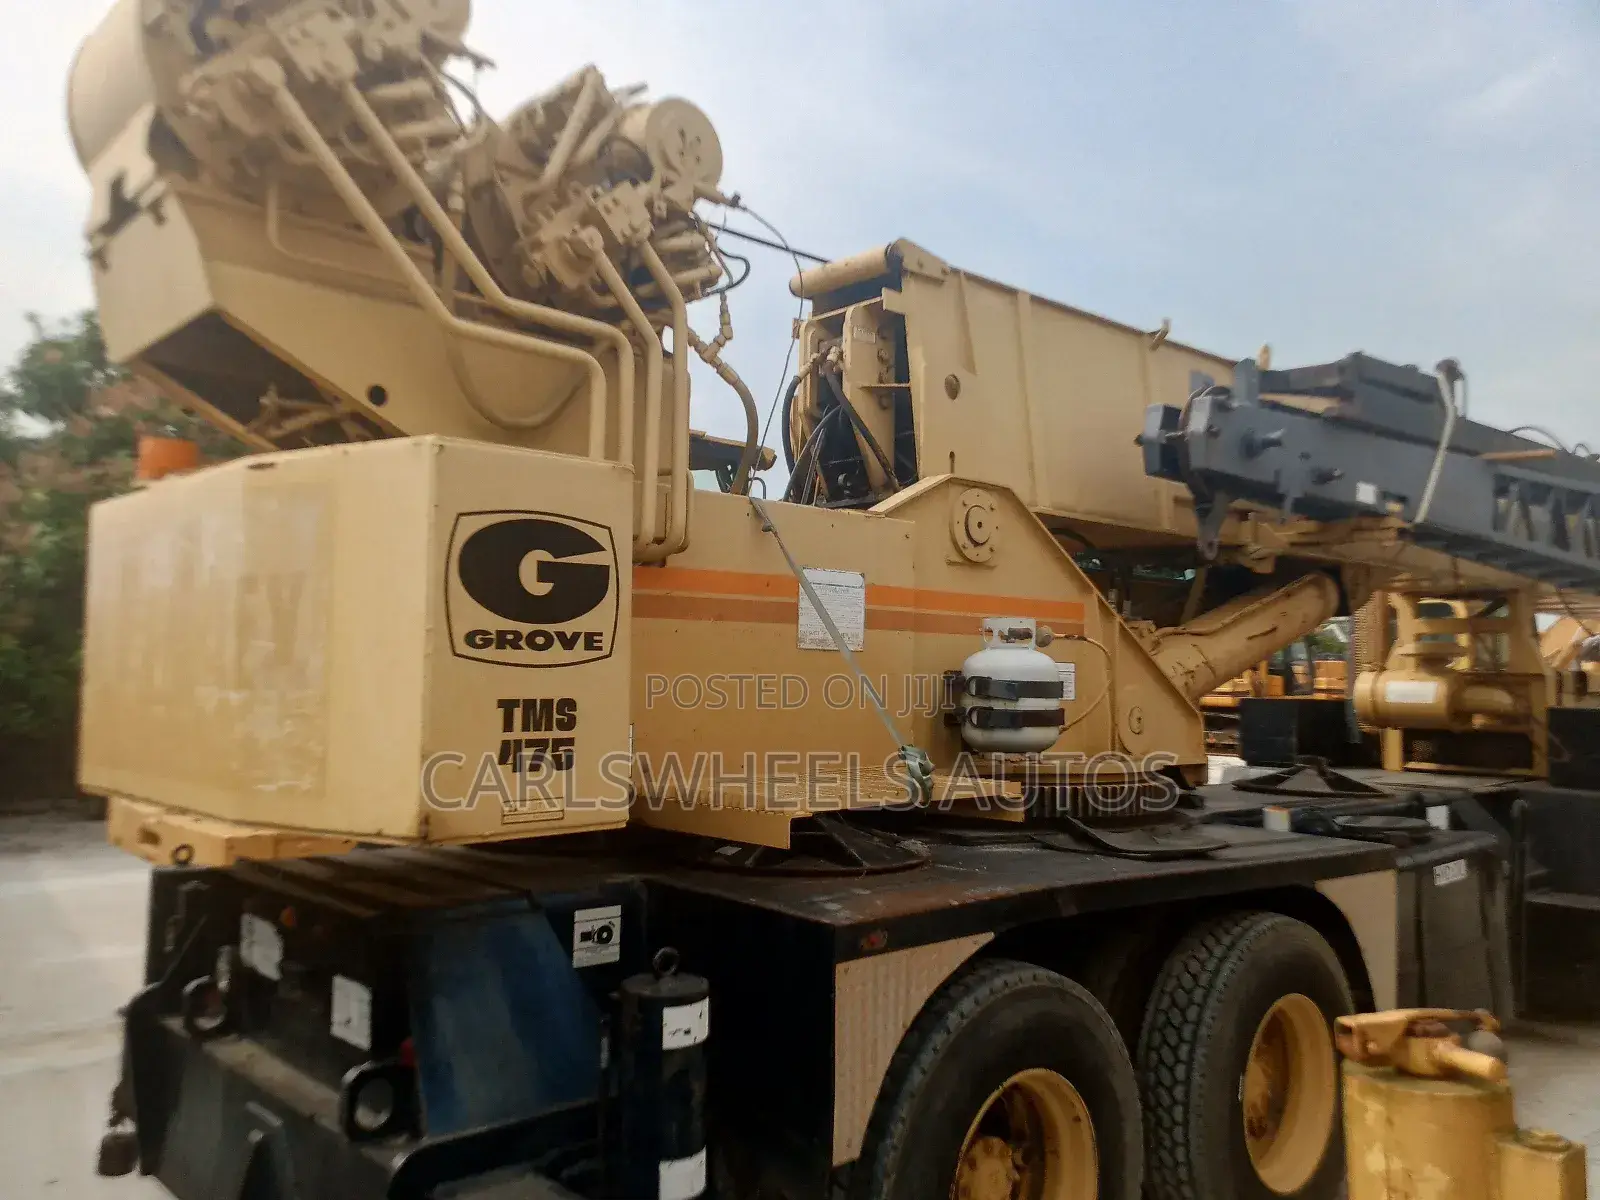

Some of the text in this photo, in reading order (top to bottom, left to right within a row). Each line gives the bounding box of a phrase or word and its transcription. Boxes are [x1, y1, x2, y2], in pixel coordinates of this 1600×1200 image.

[458, 518, 610, 625] G
[463, 629, 604, 652] GROVE
[497, 698, 577, 733] TMS
[498, 737, 575, 774] 475
